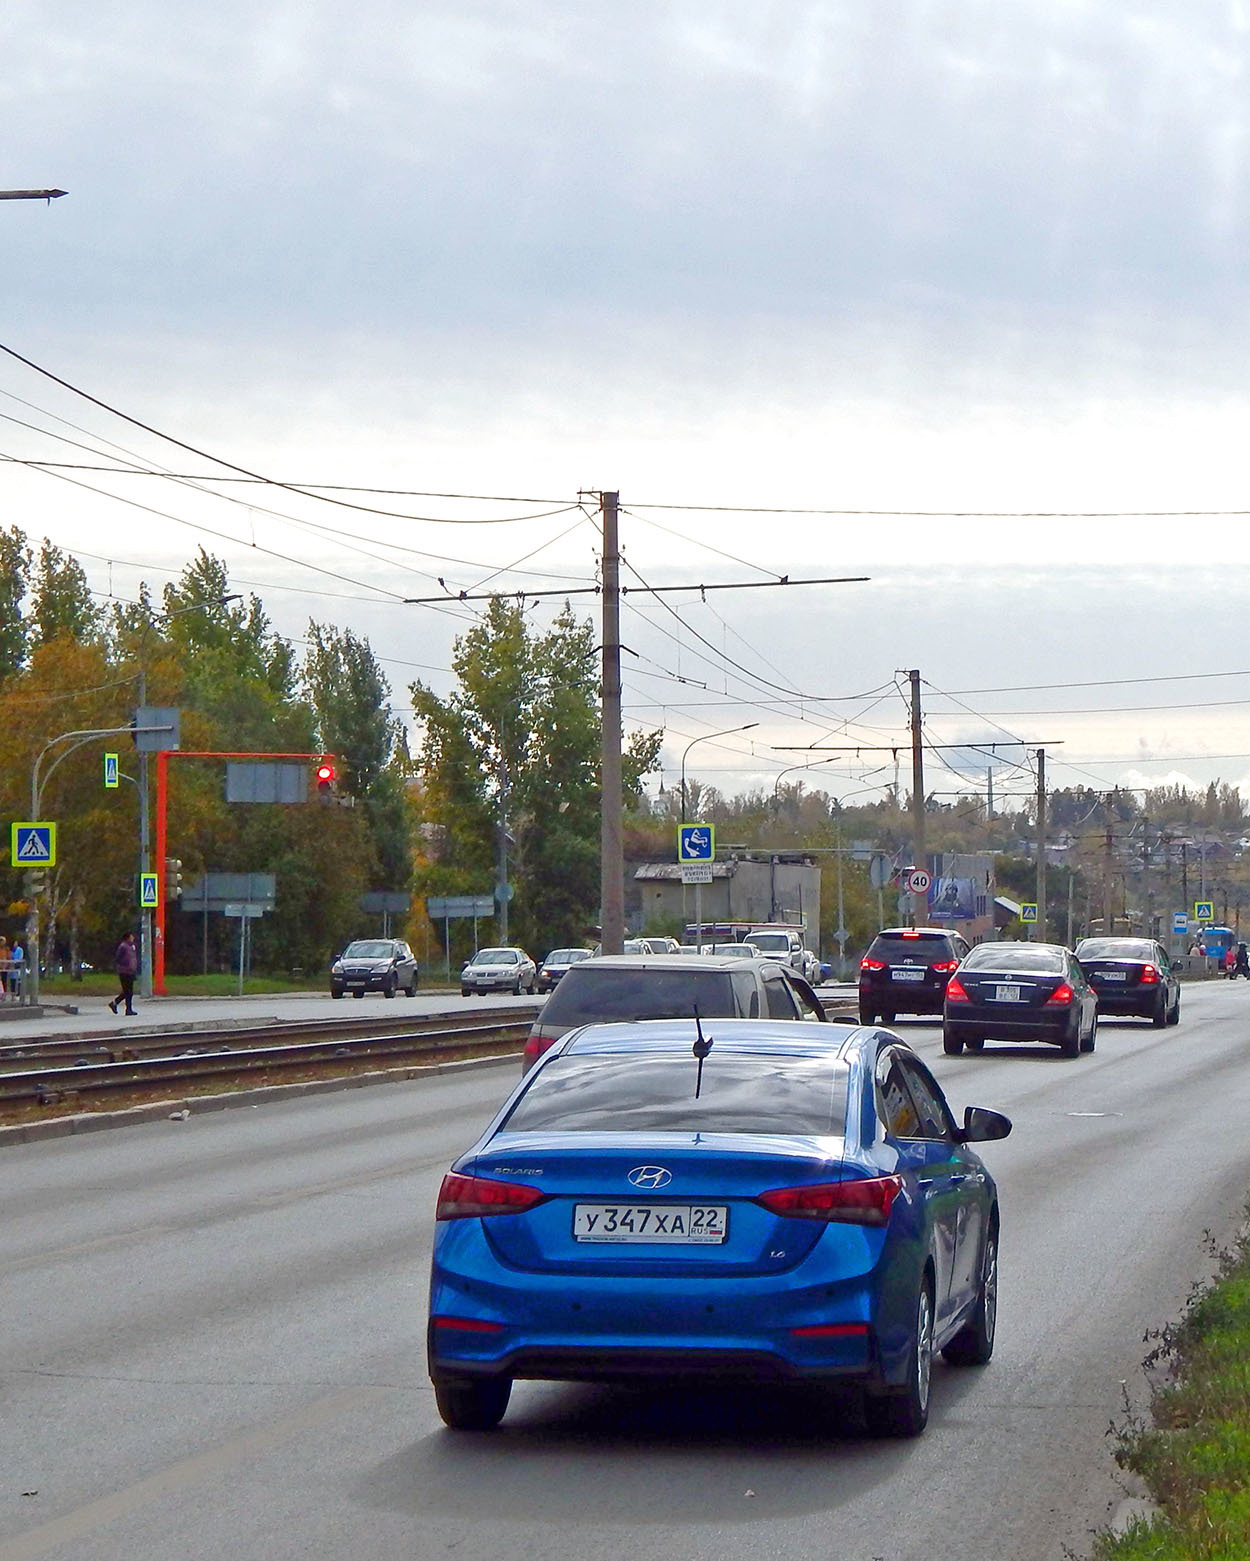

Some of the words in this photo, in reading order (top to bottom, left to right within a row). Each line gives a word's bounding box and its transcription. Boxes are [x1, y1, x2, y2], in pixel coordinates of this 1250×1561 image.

[912, 876, 927, 887] 40
[693, 1209, 718, 1228] 22
[690, 1227, 708, 1235] RUS
